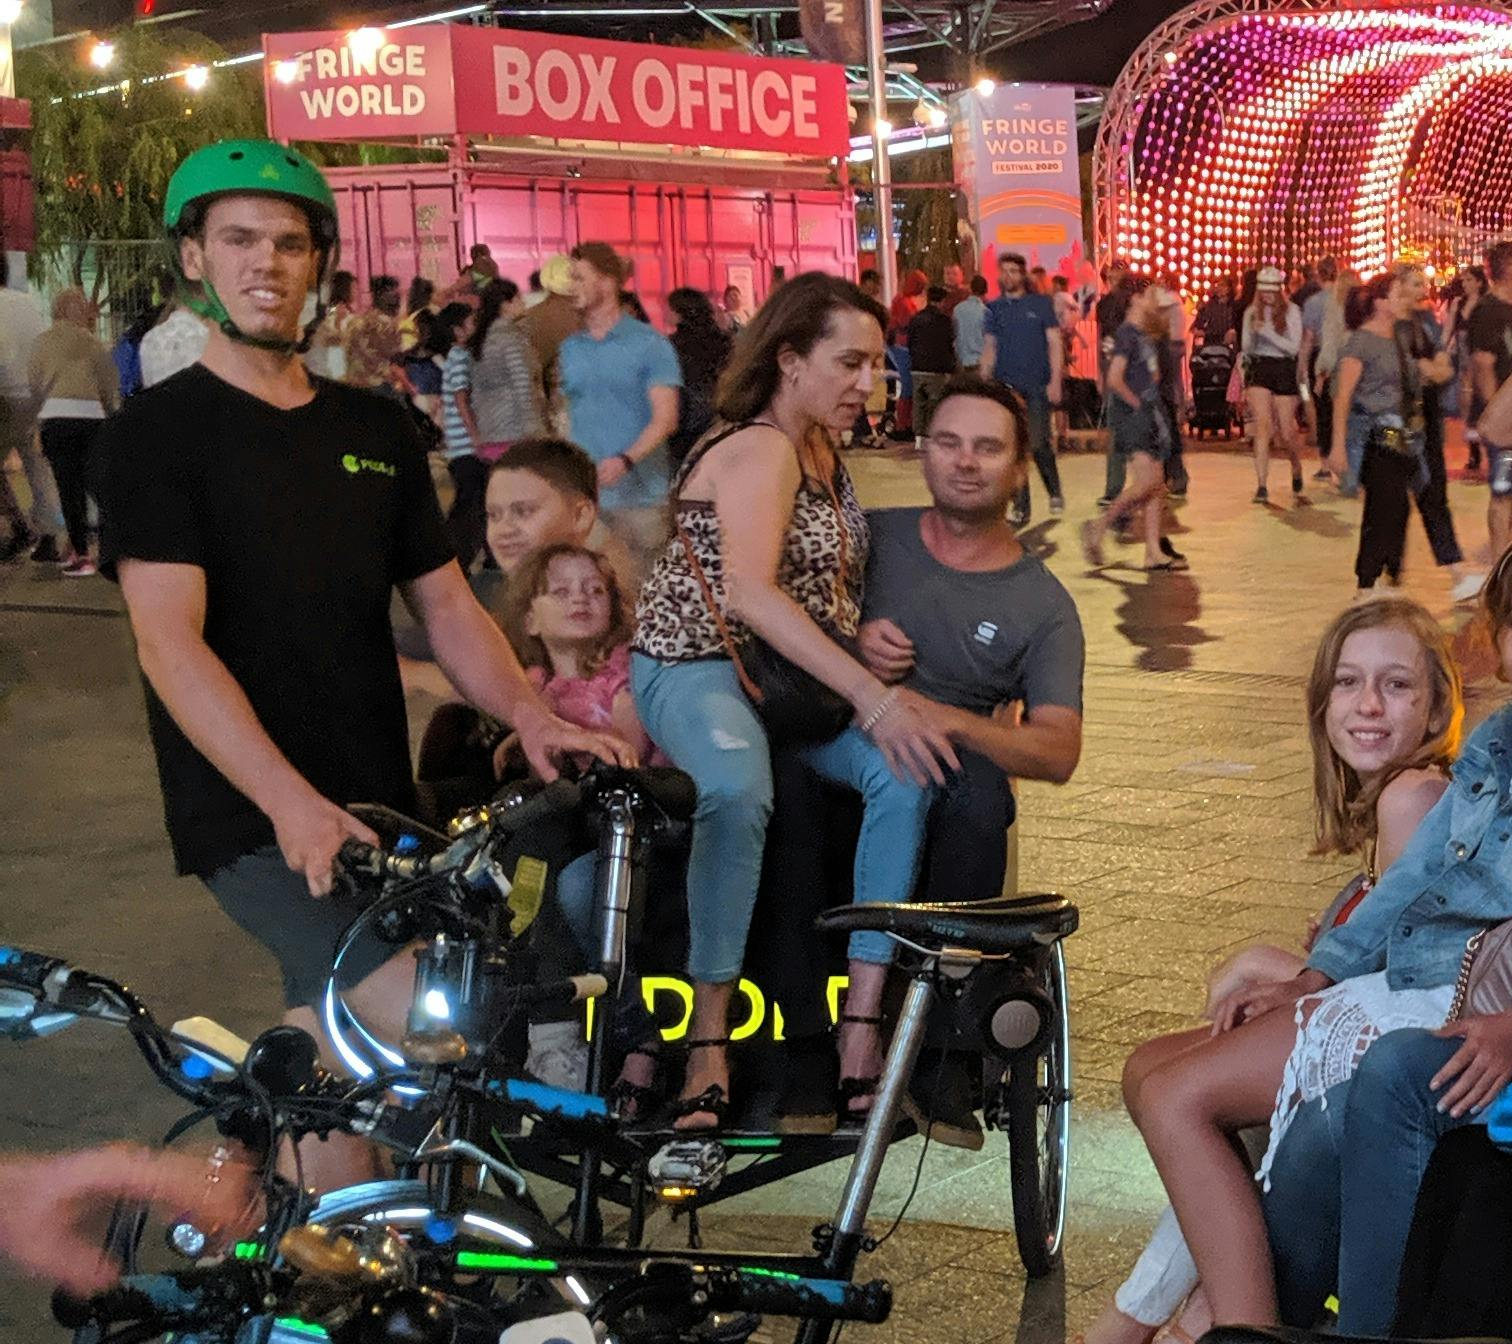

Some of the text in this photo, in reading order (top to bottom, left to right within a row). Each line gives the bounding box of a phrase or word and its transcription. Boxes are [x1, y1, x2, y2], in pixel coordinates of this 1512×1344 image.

[296, 44, 427, 83] FRINGE
[300, 83, 426, 120] WORLD
[492, 44, 821, 139] BOX OFFICE
[981, 118, 1069, 136] FRINGE
[984, 138, 1068, 156] WORLD
[995, 162, 1059, 173] FESTIVAL 2020
